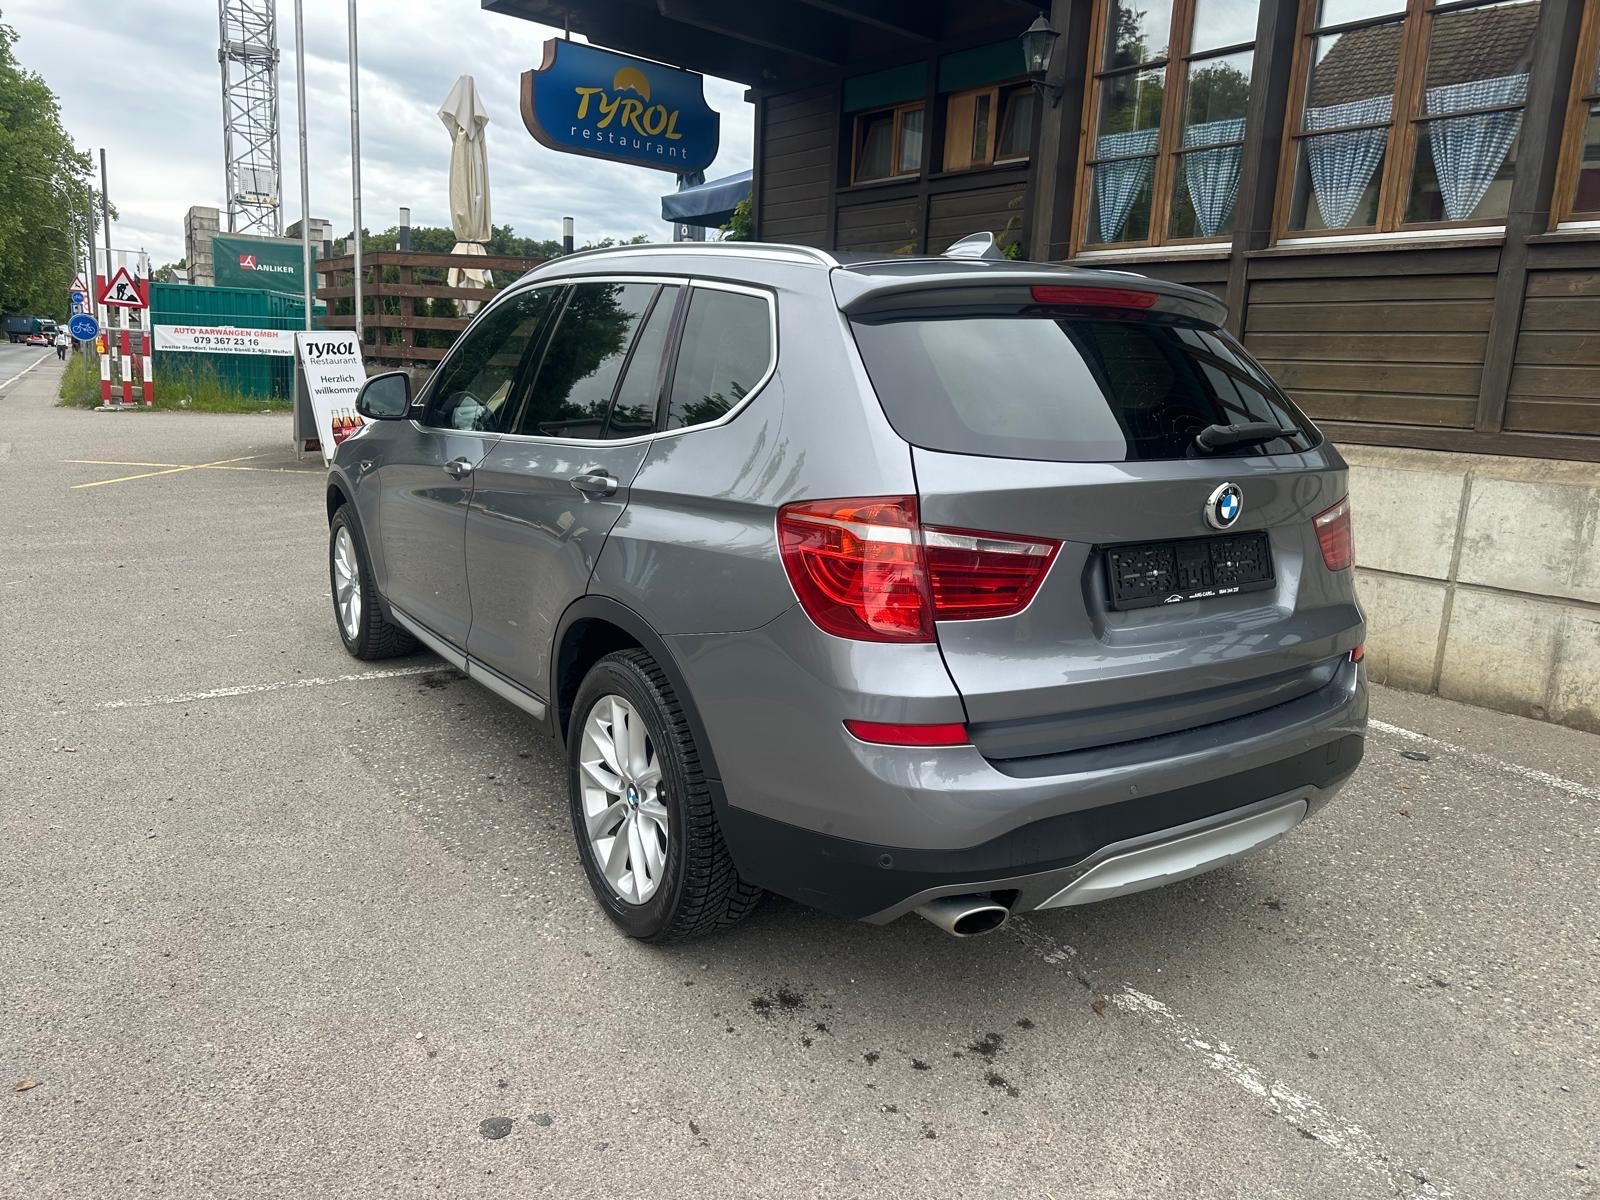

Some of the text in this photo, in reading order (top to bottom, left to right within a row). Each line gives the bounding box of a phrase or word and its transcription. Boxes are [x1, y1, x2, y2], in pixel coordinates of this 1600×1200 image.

[575, 86, 683, 140] TYROL
[571, 126, 687, 159] restaurant
[257, 264, 294, 273] ANLIKER
[173, 327, 197, 335] AUTO
[254, 330, 279, 338] GMBH
[193, 336, 259, 346] 079 367 23 16
[306, 342, 355, 358] TYROL
[310, 357, 358, 365] Restaurant
[320, 375, 355, 383] Herzlich
[314, 386, 360, 395] willkomme
